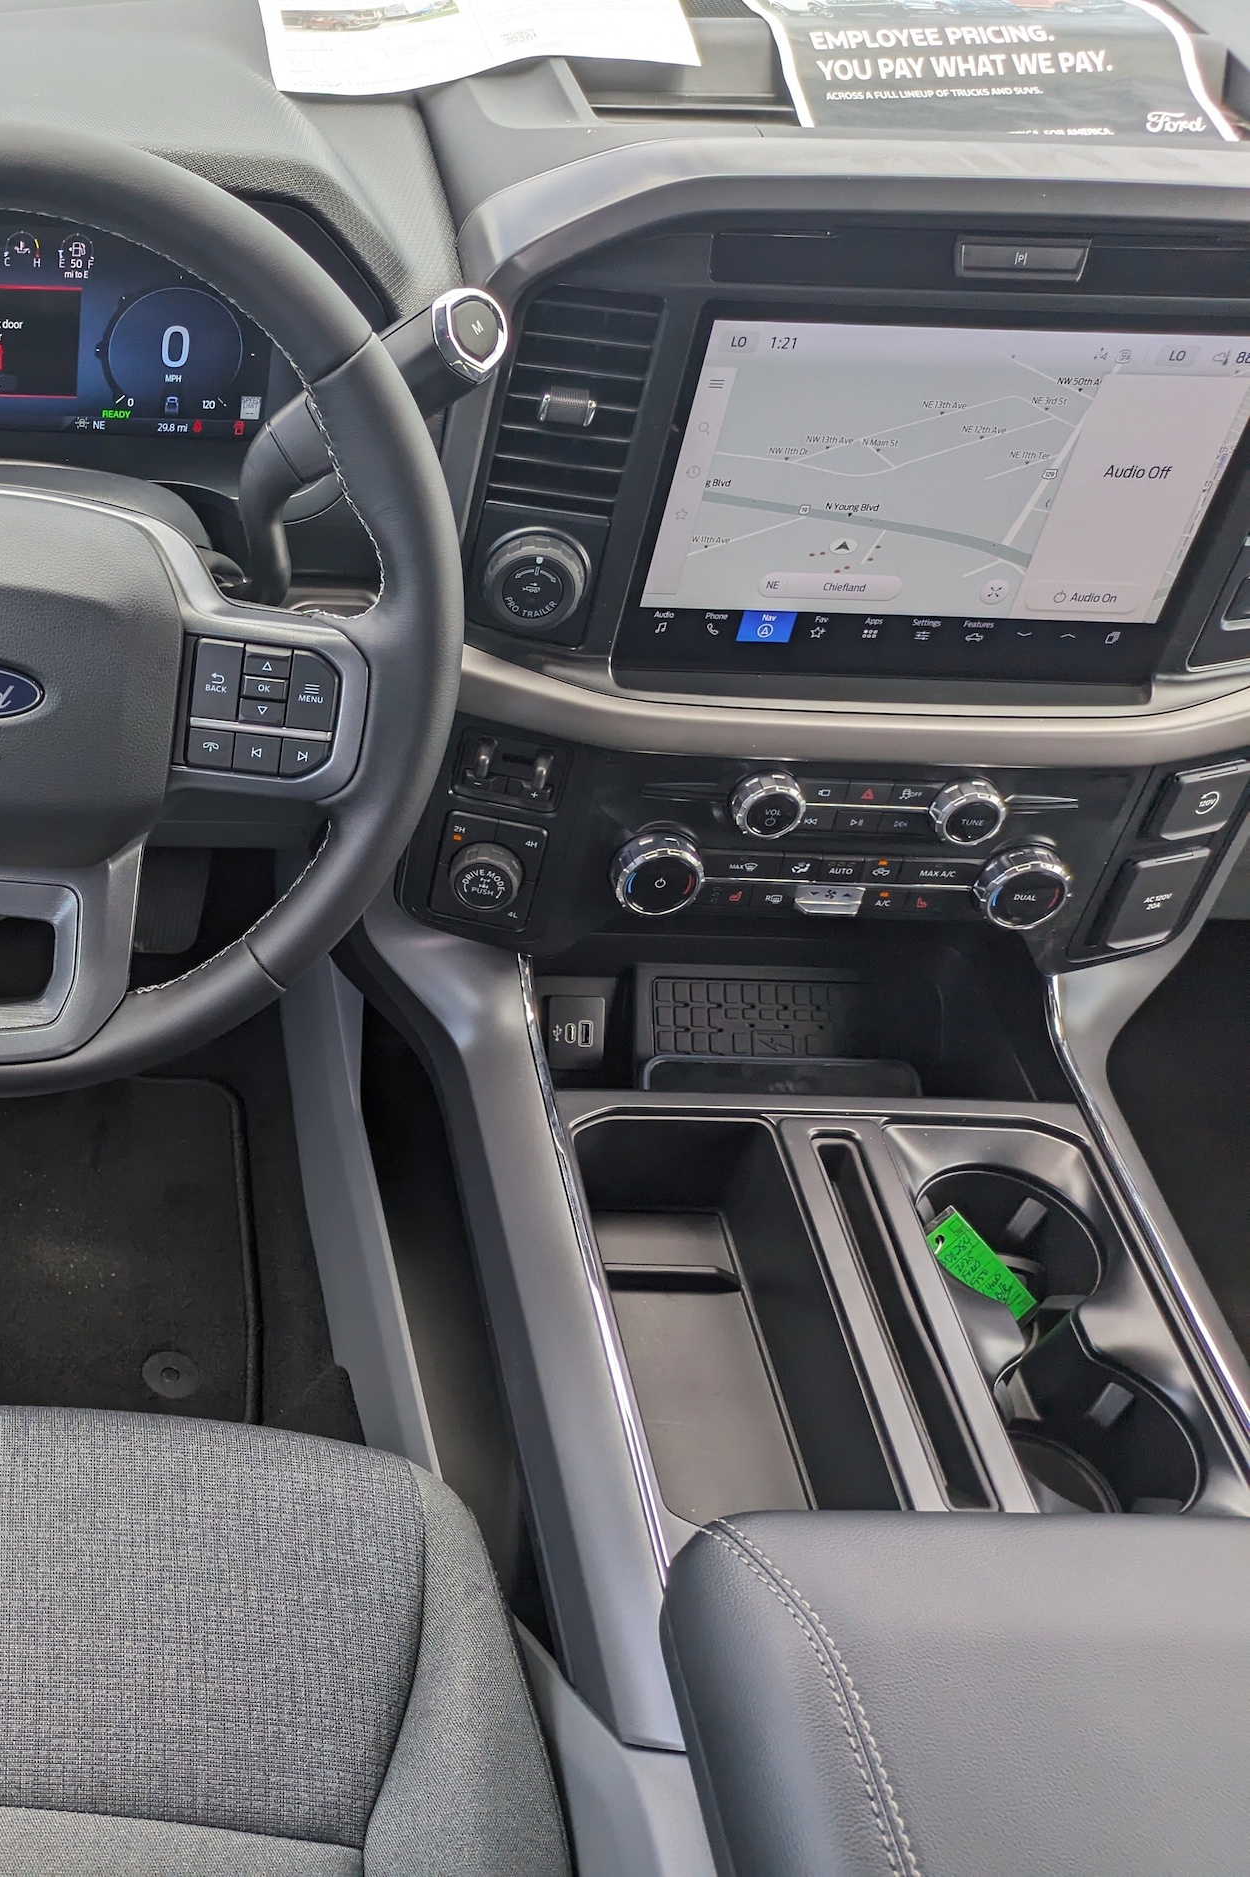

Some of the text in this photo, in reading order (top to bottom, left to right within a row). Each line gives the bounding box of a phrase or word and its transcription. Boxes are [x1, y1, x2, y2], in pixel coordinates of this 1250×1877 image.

[809, 25, 1055, 50] EMPLOYEE PRICING.
[816, 50, 1114, 81] YOU PAY WHAT WE PAY.
[826, 86, 1043, 101] ACROSS A FULL LINEUP OF TRUCKS AND SUVS.
[1146, 111, 1206, 132] Ford
[1067, 128, 1115, 136] AMERICA.
[4, 258, 10, 267] C
[34, 258, 40, 267] H
[59, 259, 65, 268] E
[70, 260, 83, 269] 50
[2, 319, 23, 329] door
[161, 325, 190, 368] 0
[730, 336, 747, 348] LO
[770, 337, 798, 350] 1:21
[1168, 350, 1186, 361] LO
[127, 398, 134, 407] 0
[202, 400, 215, 410] 120
[935, 401, 951, 409] 13th
[102, 410, 131, 418] READY
[93, 421, 105, 429] NE
[157, 423, 188, 432] 29.8 mi
[1104, 465, 1173, 479] Audio Off
[712, 479, 731, 487] Blvd
[825, 502, 879, 512] N Young Blvd
[766, 580, 779, 590] NE
[823, 582, 867, 592] Chiefland
[1069, 592, 1117, 603] Audio On
[505, 596, 558, 618] PRO TRAILER
[705, 612, 728, 621] Phone
[815, 616, 828, 624] Fav
[865, 617, 883, 626] Apps
[912, 618, 941, 628] Settings
[963, 620, 994, 629] Features
[205, 684, 227, 693] BACK
[258, 684, 270, 693] OK
[298, 694, 324, 704] MENU
[961, 819, 984, 827] TUNE
[462, 869, 505, 891] DRIVE MODE
[471, 886, 494, 896] PUSH
